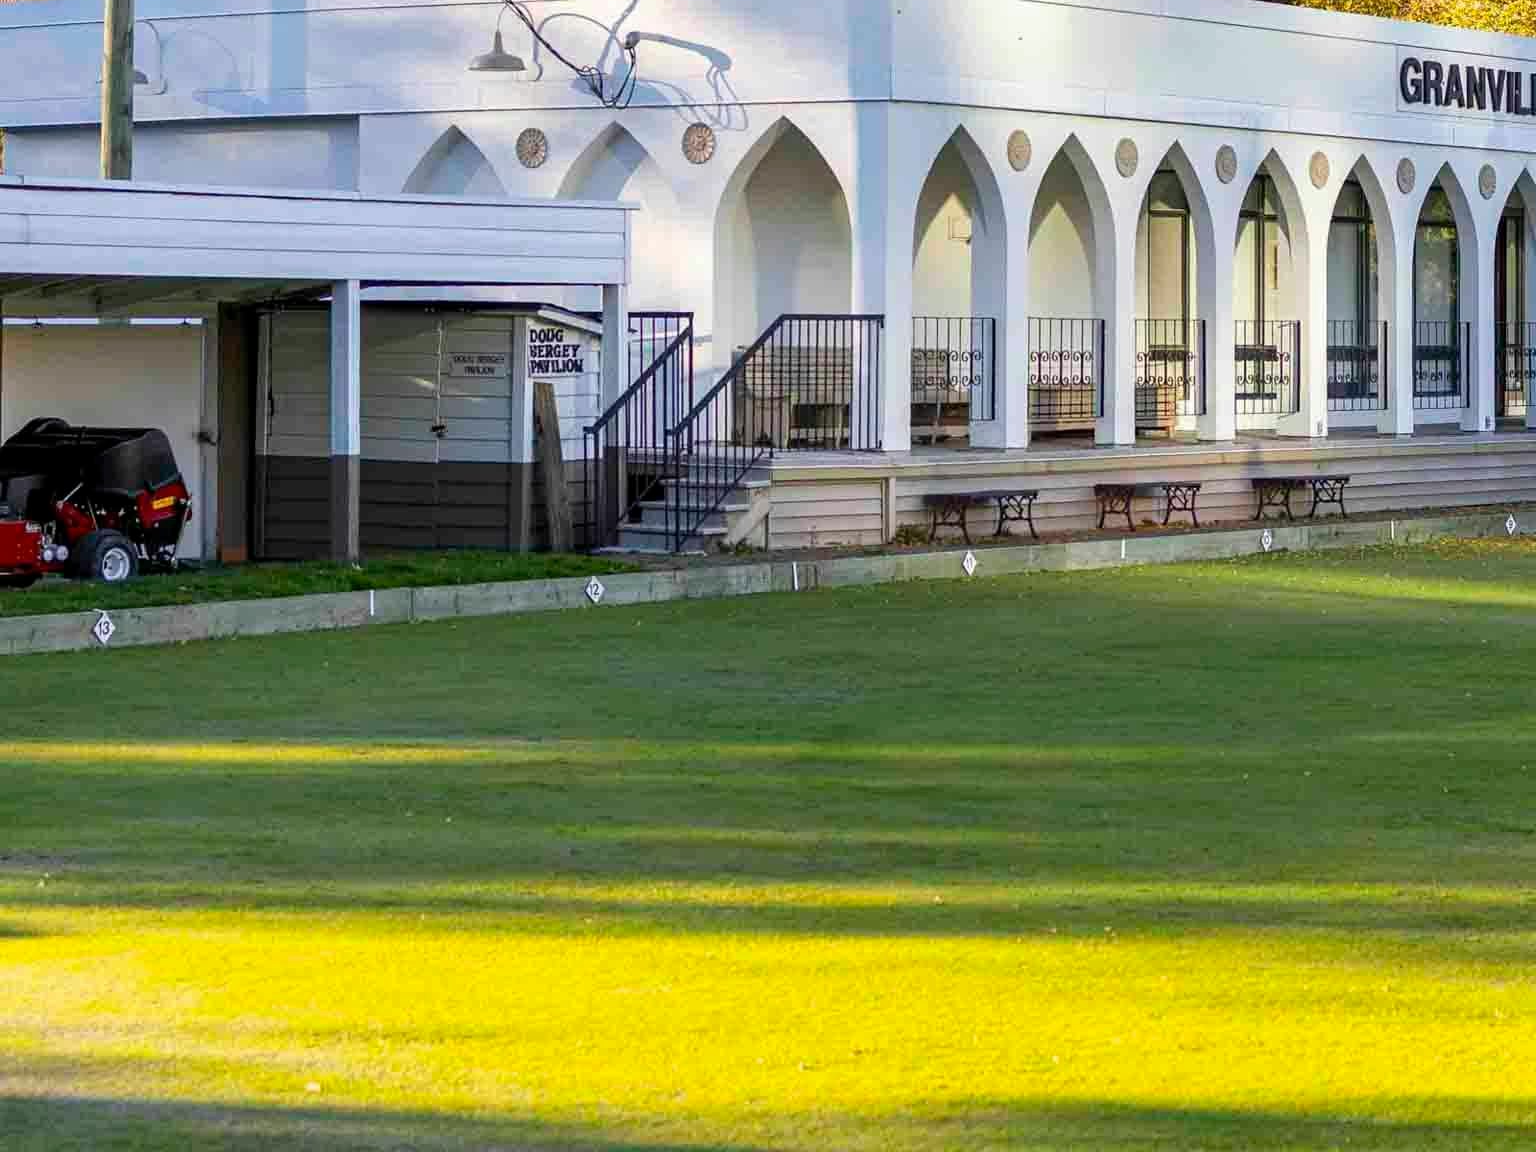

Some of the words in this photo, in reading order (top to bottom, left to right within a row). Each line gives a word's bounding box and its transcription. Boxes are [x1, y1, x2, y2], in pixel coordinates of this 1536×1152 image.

[529, 328, 563, 344] DOUG
[529, 343, 581, 358] BERGEY
[529, 358, 584, 374] PAVILION
[589, 583, 600, 596] 12
[99, 620, 110, 636] 13
